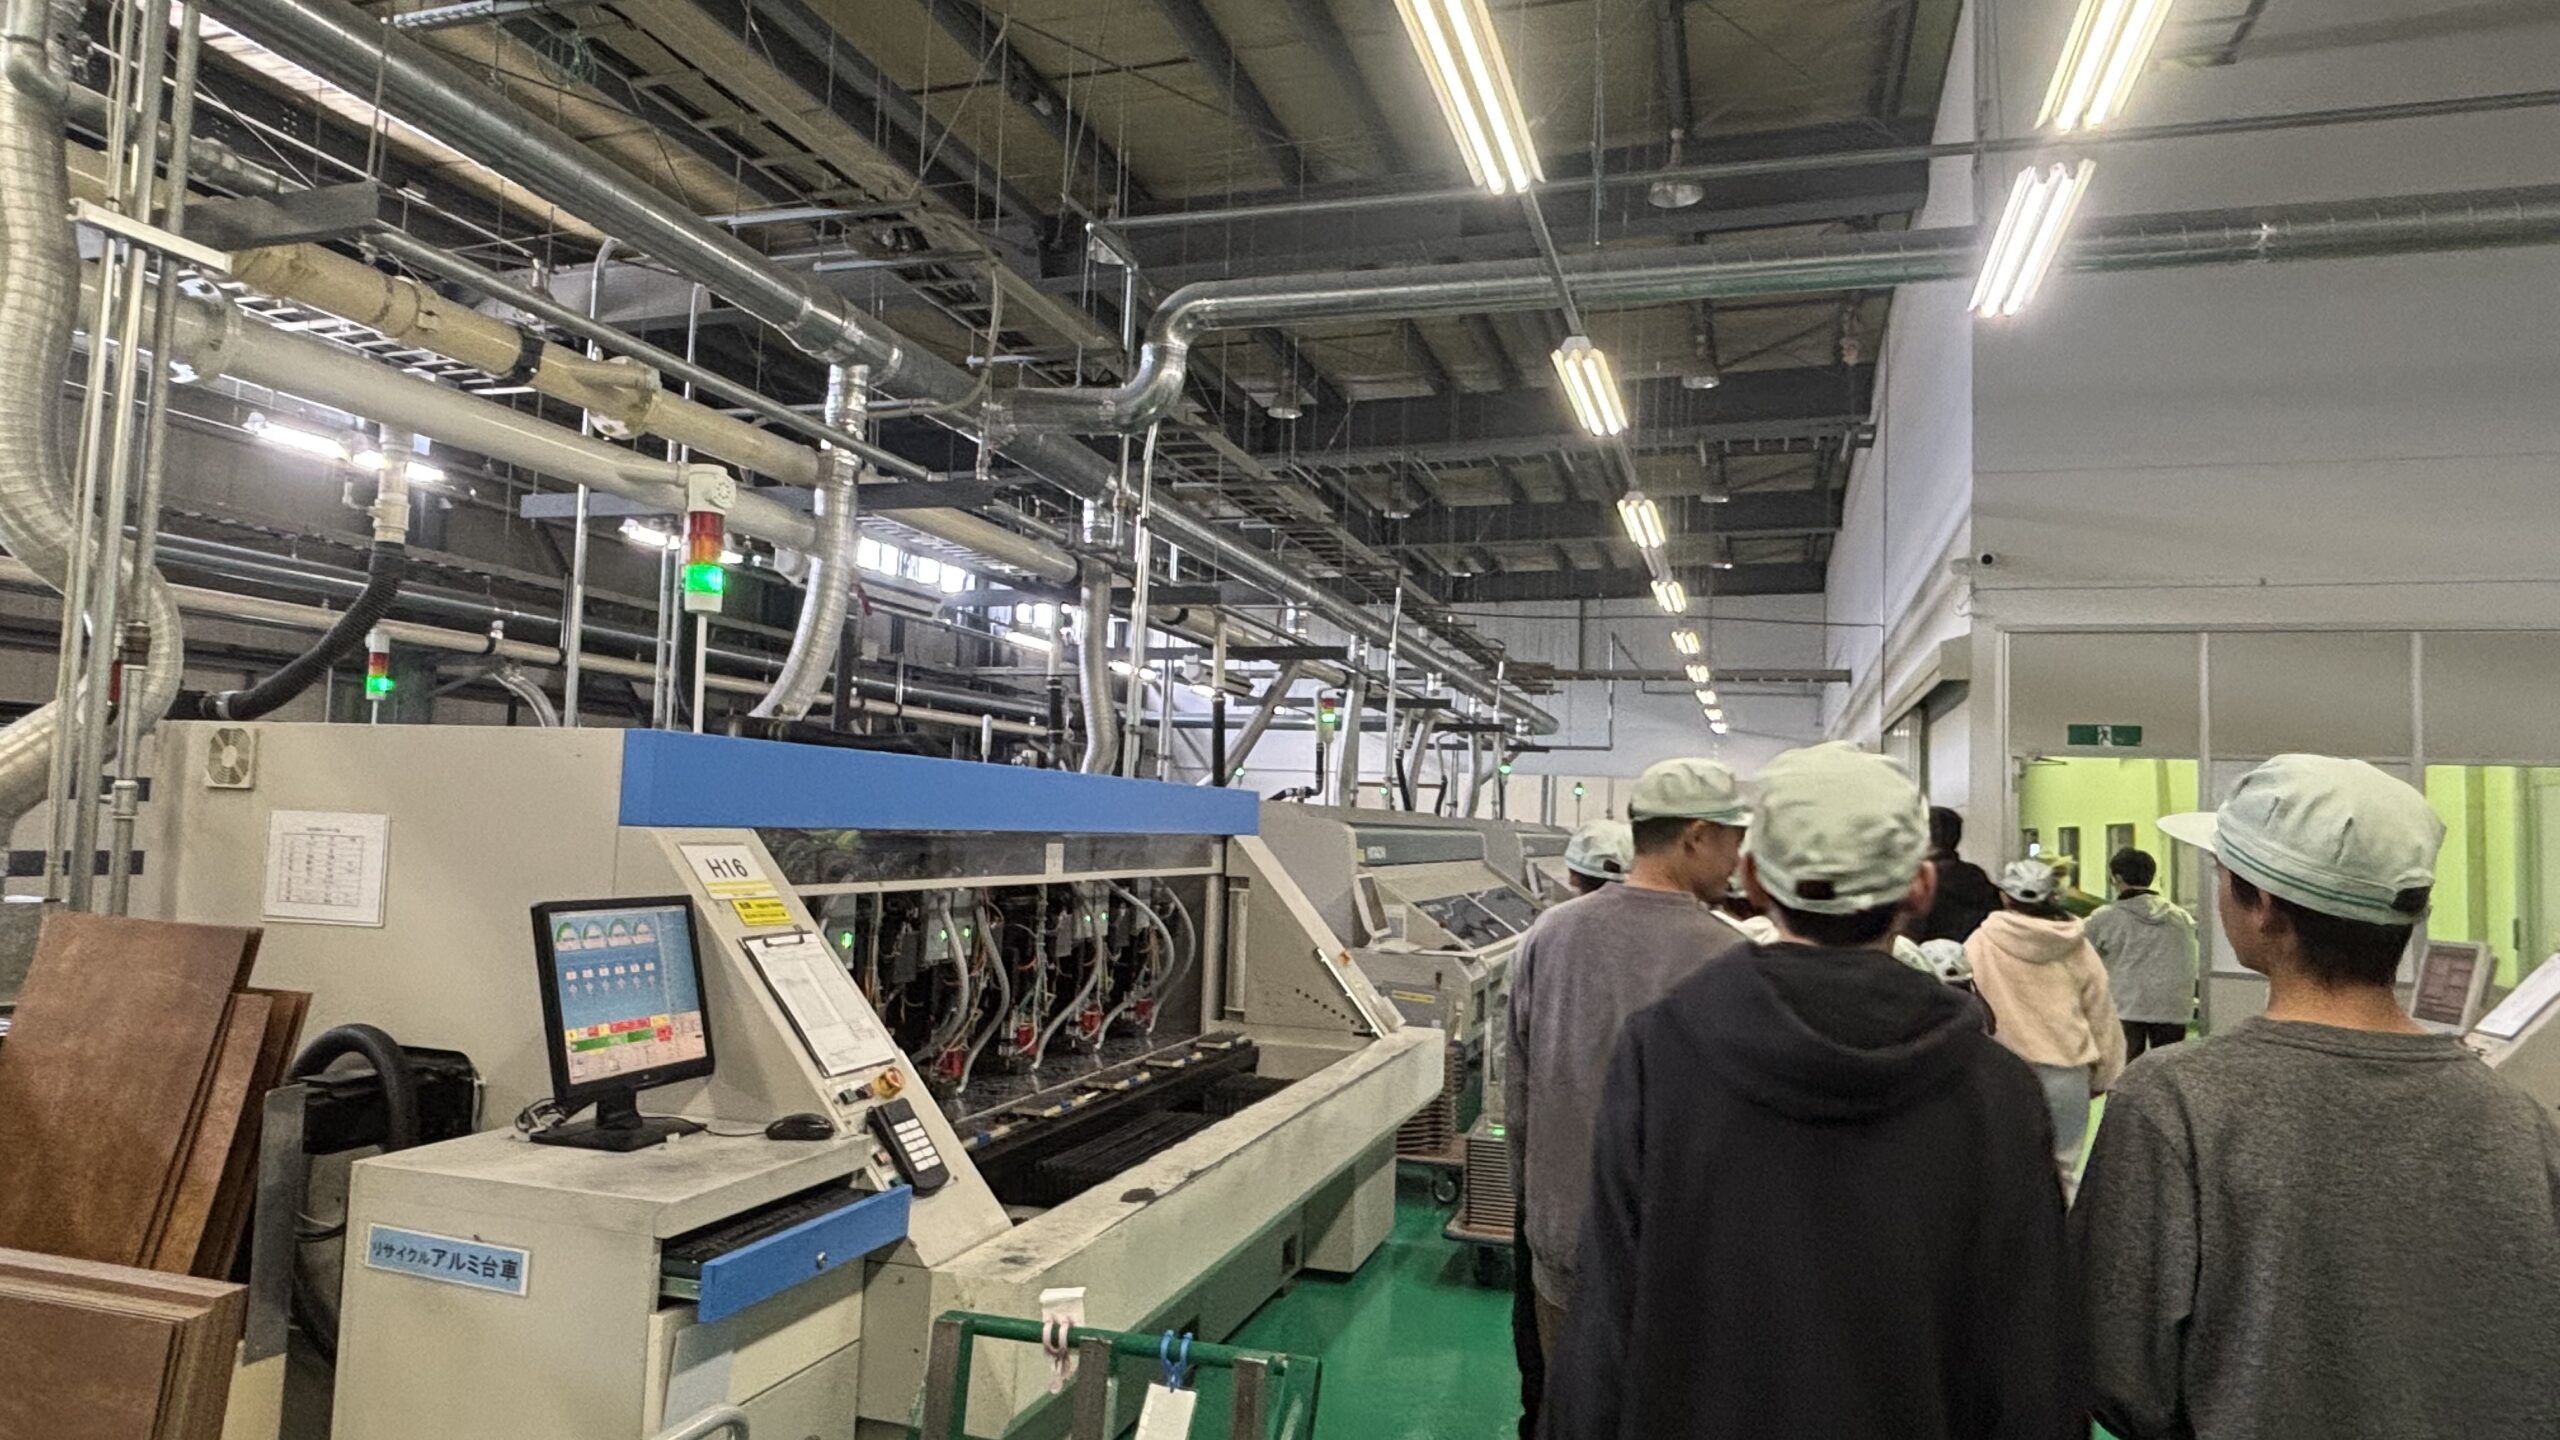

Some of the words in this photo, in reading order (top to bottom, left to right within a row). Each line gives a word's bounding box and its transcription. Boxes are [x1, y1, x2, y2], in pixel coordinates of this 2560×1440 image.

[705, 858, 748, 878] H16
[372, 1241, 519, 1281] リサイクルアルミ台車
